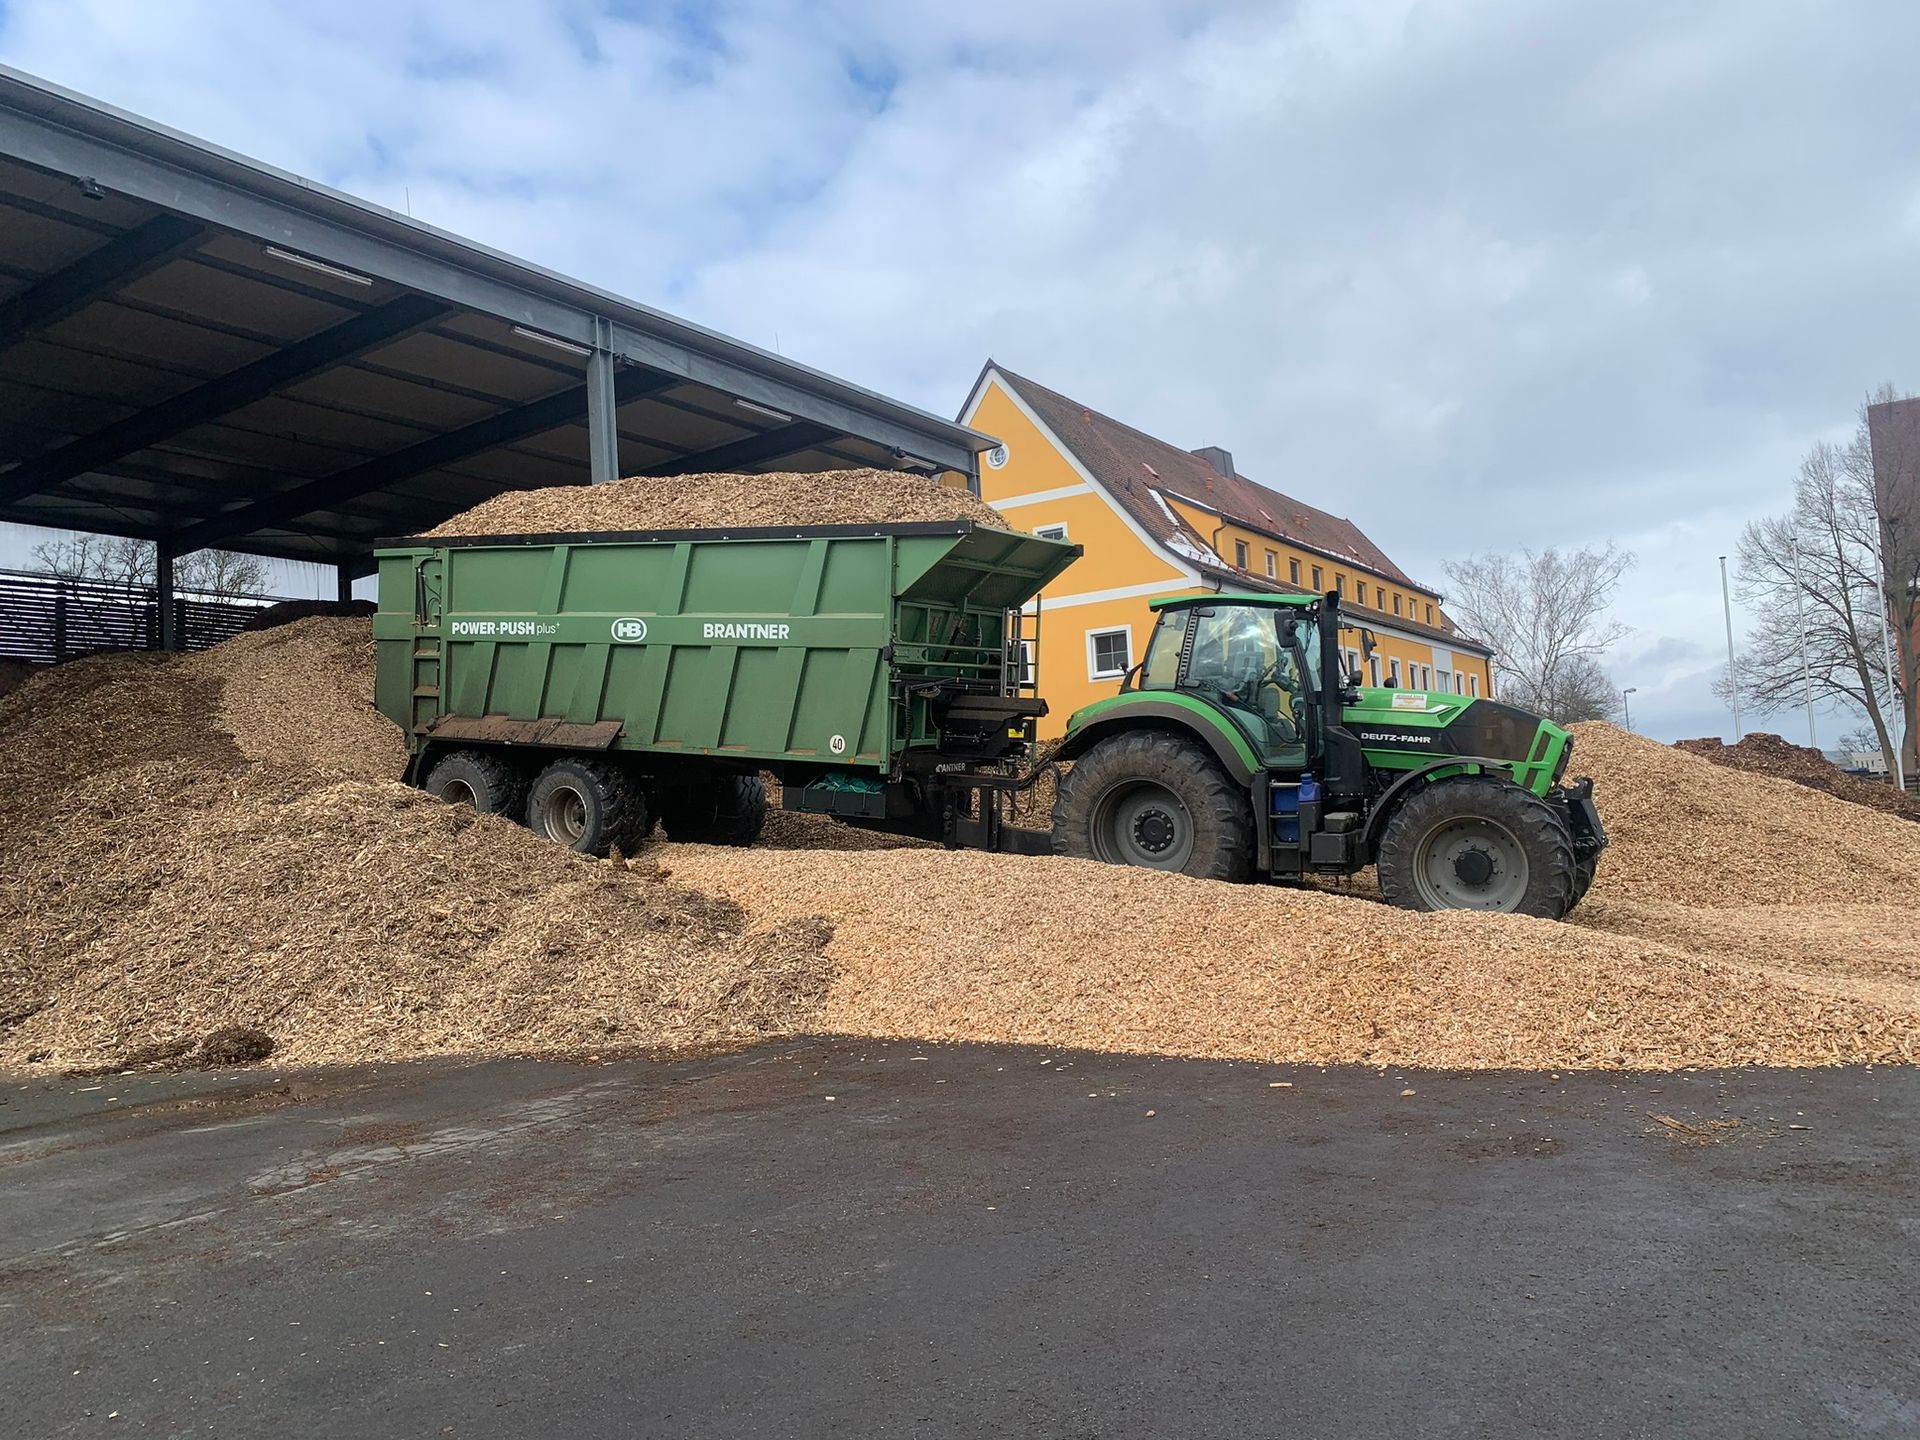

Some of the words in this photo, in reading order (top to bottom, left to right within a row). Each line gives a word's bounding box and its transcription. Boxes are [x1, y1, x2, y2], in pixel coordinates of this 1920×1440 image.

[451, 621, 535, 635] POWER-PUSH
[703, 623, 790, 639] BRANTNER
[832, 738, 843, 750] 40
[1361, 732, 1431, 743] DEUTZ-FAHR
